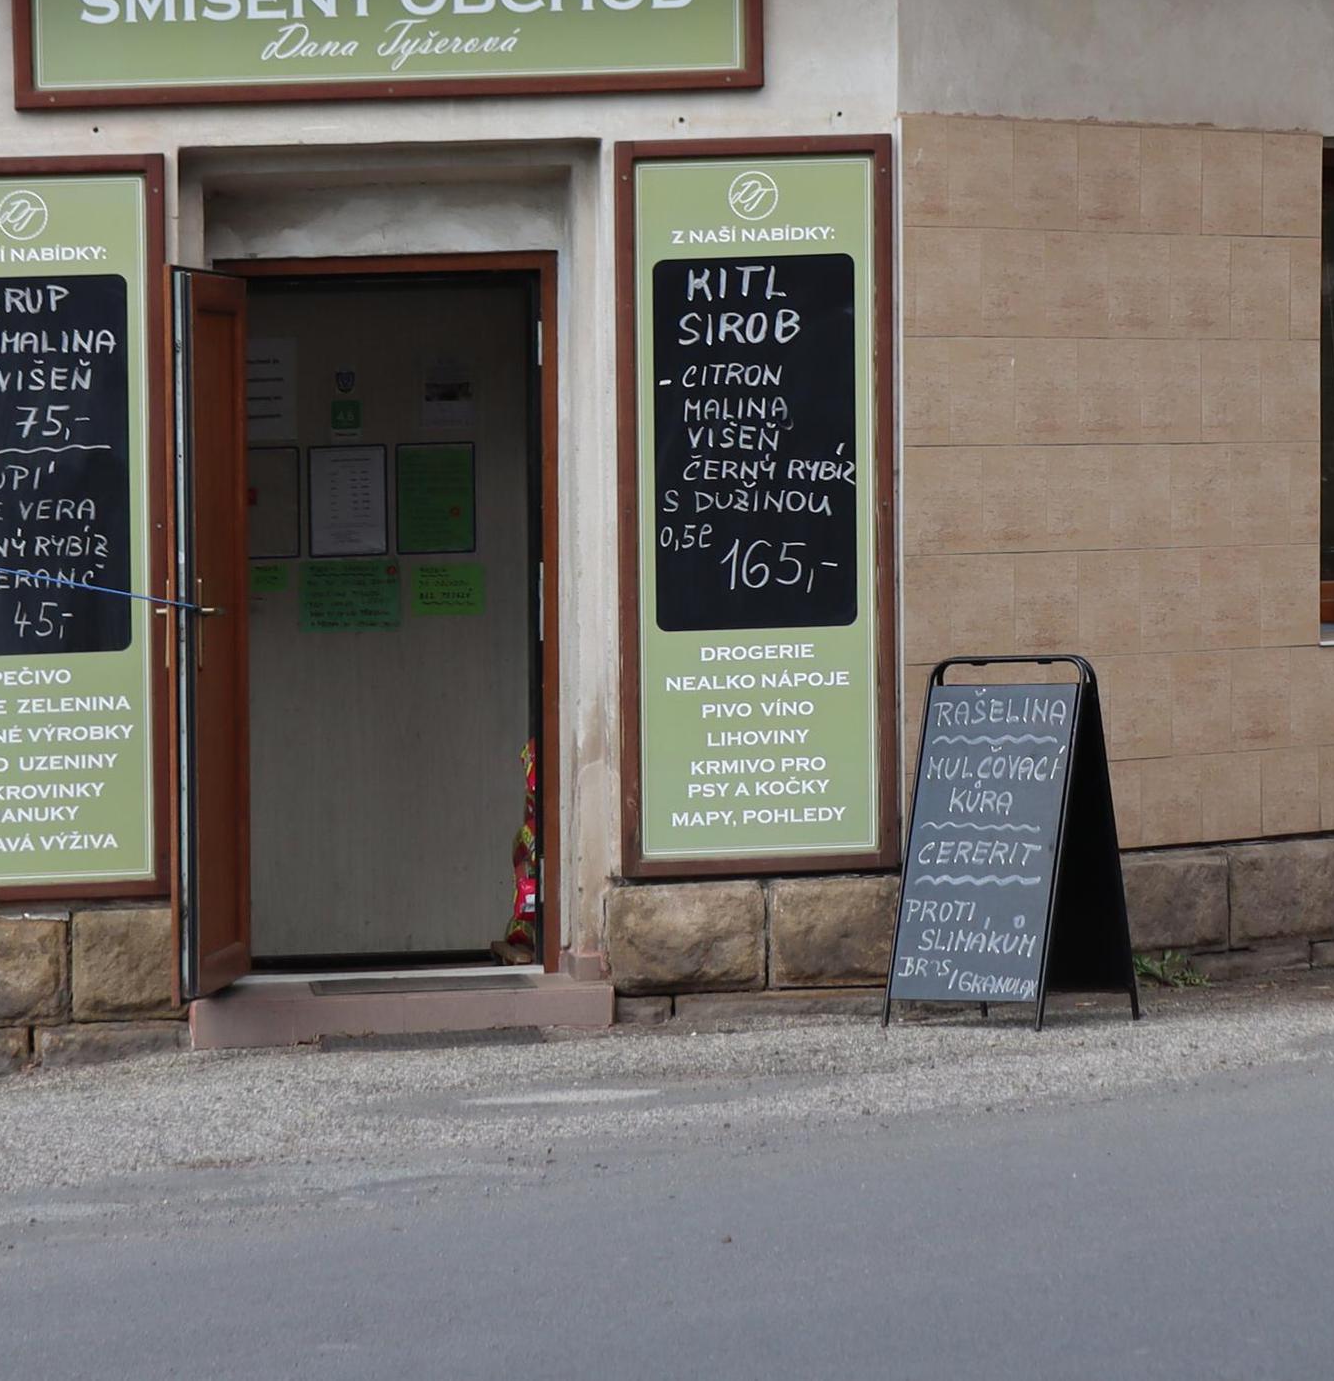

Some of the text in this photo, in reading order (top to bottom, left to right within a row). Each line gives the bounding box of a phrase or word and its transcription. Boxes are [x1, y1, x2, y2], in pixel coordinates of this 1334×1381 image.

[259, 17, 519, 73] Dana Tyšerová
[671, 224, 836, 244] Z NAŠÍ NABÍDKY:
[10, 244, 107, 262] NABÍDKY:
[687, 265, 787, 301] KITL
[678, 309, 801, 346] SIROB
[0, 329, 117, 354] MALINA
[682, 363, 782, 388] CITRON
[683, 396, 788, 423] MALINA
[16, 405, 90, 441] 75,-
[688, 421, 780, 451] VIŠEŇ
[683, 454, 776, 481] ČERNÝ
[788, 442, 856, 485] RYBÍZ
[19, 498, 96, 520] VERA
[663, 481, 833, 516] S DUŽINOU
[720, 539, 838, 593] 165,-
[14, 601, 74, 639] 45,-
[700, 643, 815, 661] DROGERIE
[666, 670, 850, 691] NEALKO NÁPOJE
[17, 695, 131, 714] ZELENINA
[702, 698, 814, 719] PIVO VÍNO
[934, 688, 1067, 727] RAŠELINA
[28, 724, 134, 743] VÝROBKY
[707, 729, 810, 747] LIHOVINY
[19, 754, 118, 771] UZENINY
[690, 757, 826, 775] KRMIVO PRO
[926, 745, 1065, 781] MULČOVACÍ
[688, 777, 830, 798] PSY A KOČKY
[948, 779, 1013, 815] KŮRA
[671, 806, 847, 827] MAPY, POHLEDY
[40, 830, 119, 850] VÝŽIVA
[918, 840, 1042, 866] CERERIT
[906, 898, 976, 923] PROTI
[918, 915, 1037, 958] SLIMÁKŮM
